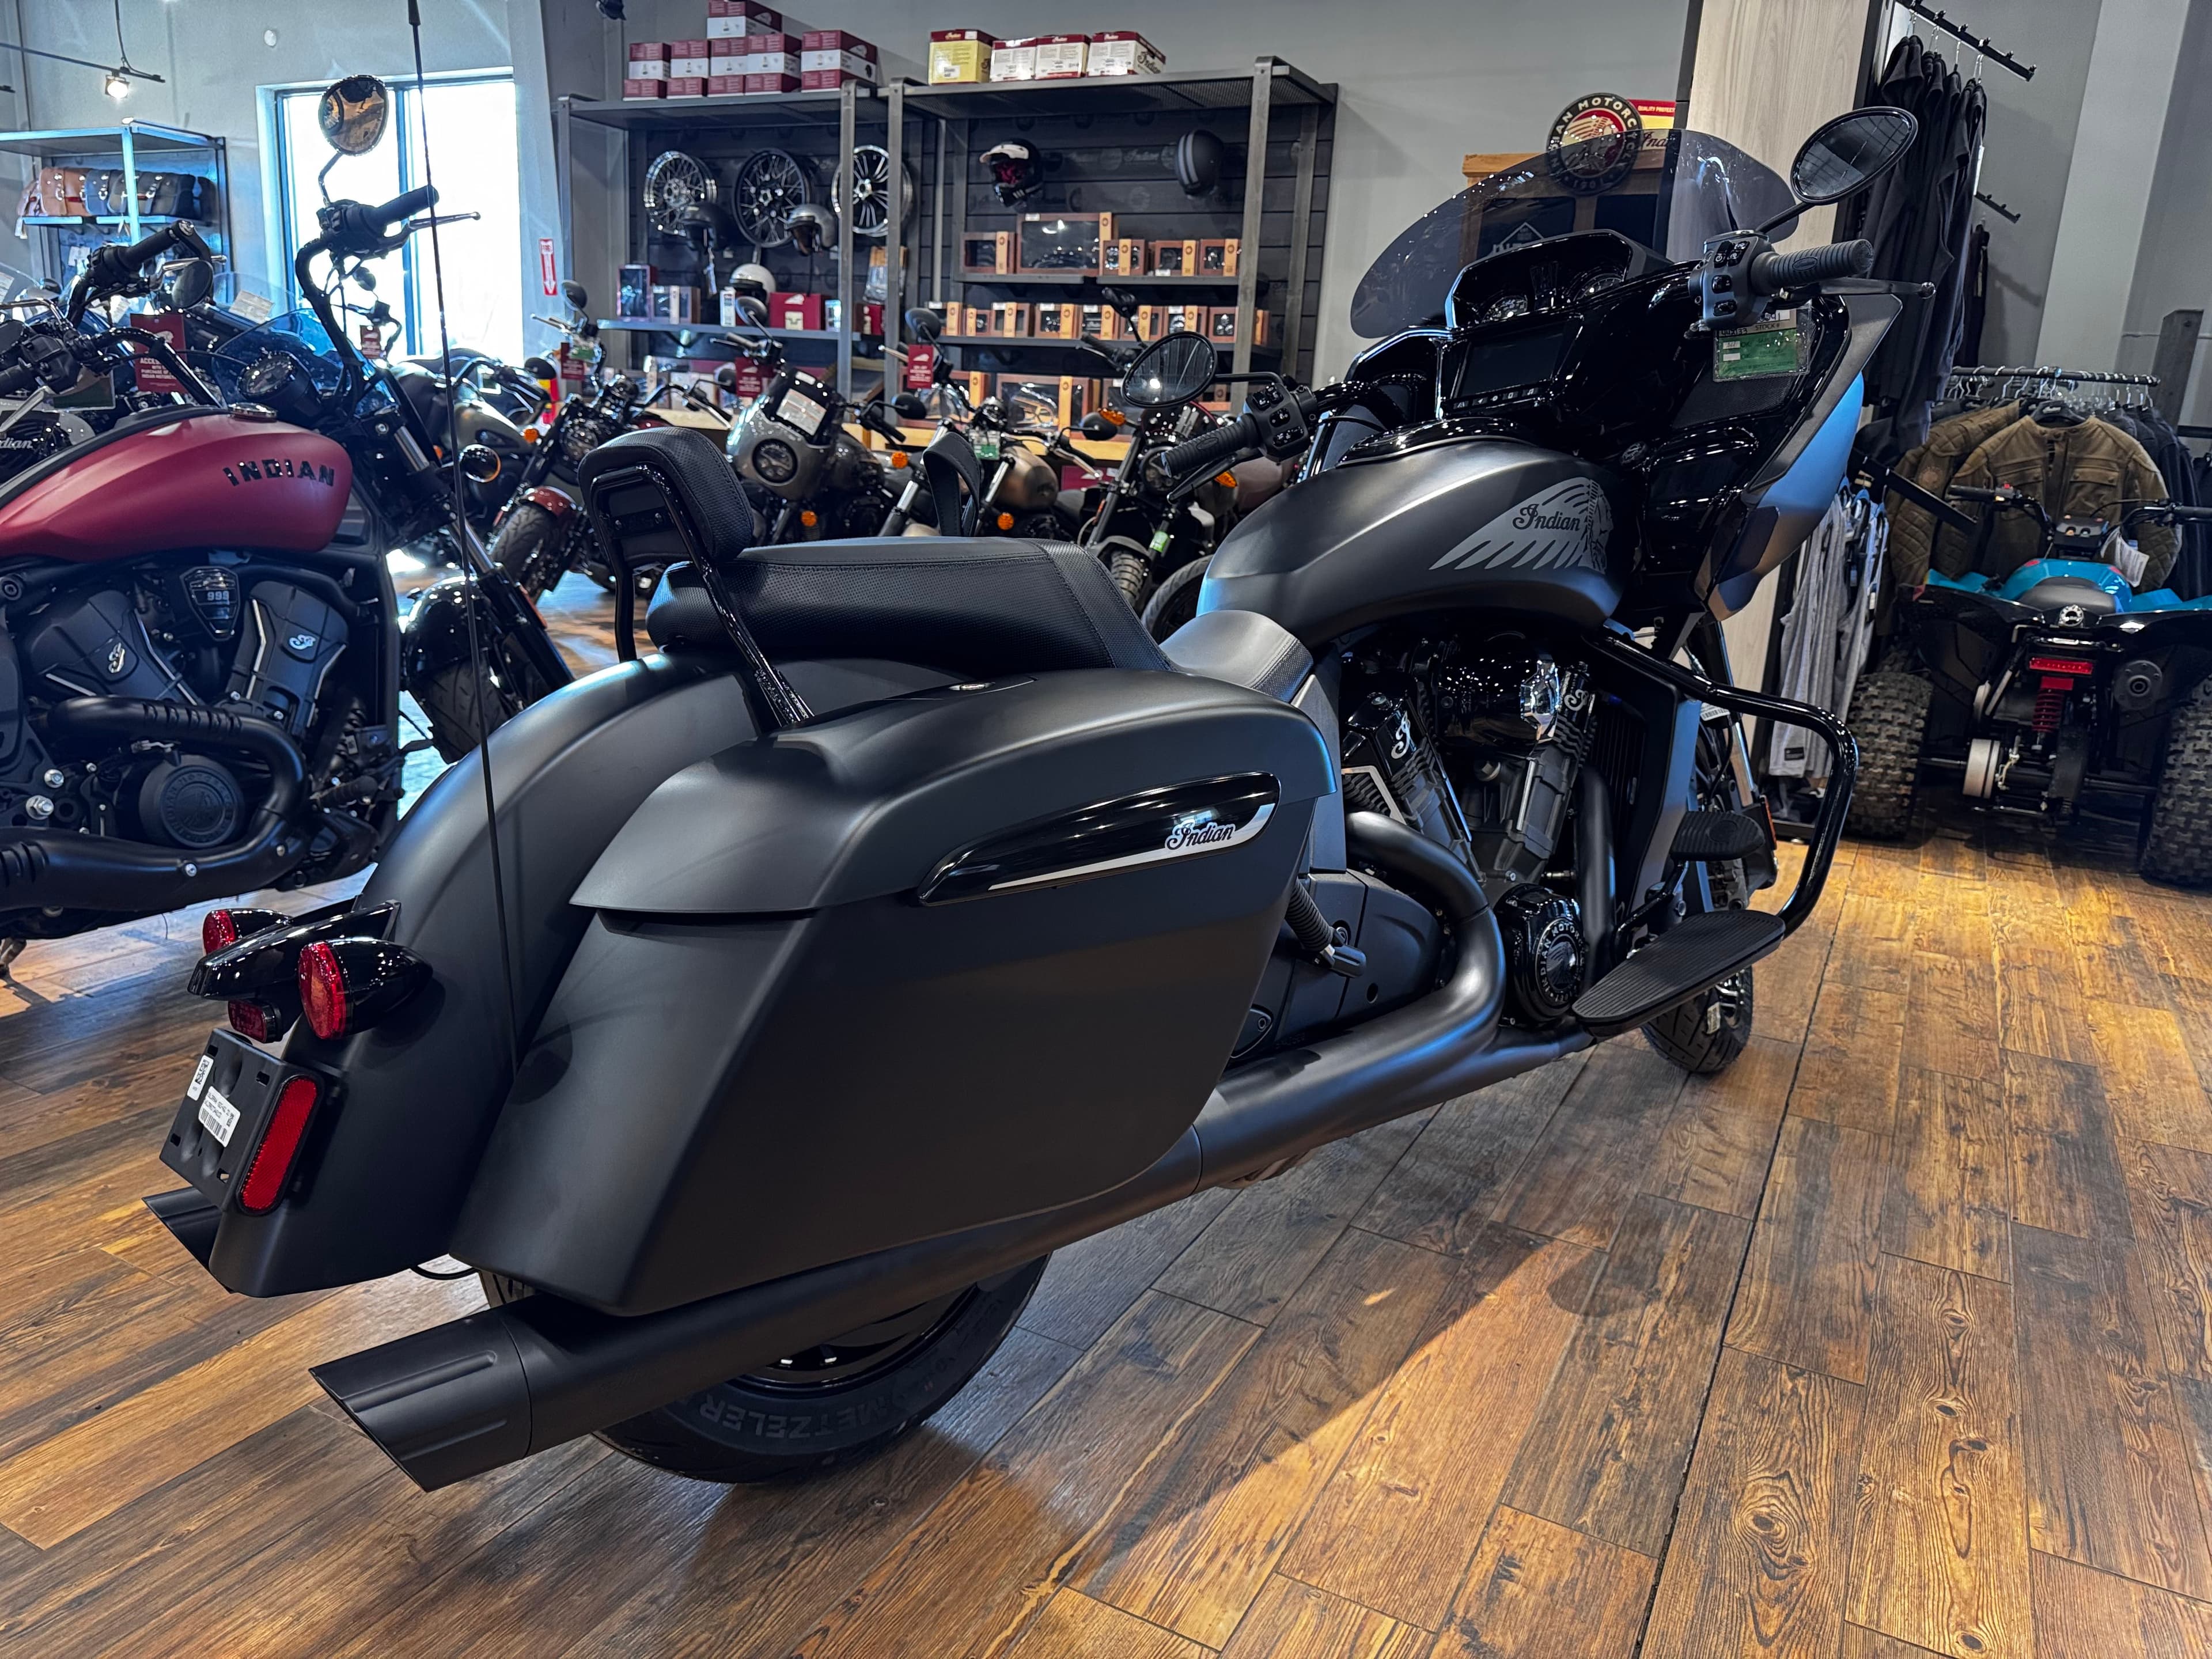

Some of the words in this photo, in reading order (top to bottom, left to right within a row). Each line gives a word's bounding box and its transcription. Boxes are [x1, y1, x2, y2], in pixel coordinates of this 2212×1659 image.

[222, 459, 335, 487] INDIAN
[1513, 503, 1581, 531] Indian
[207, 590, 230, 601] 999
[1166, 820, 1232, 850] Indian
[699, 1394, 888, 1440] METZELER
